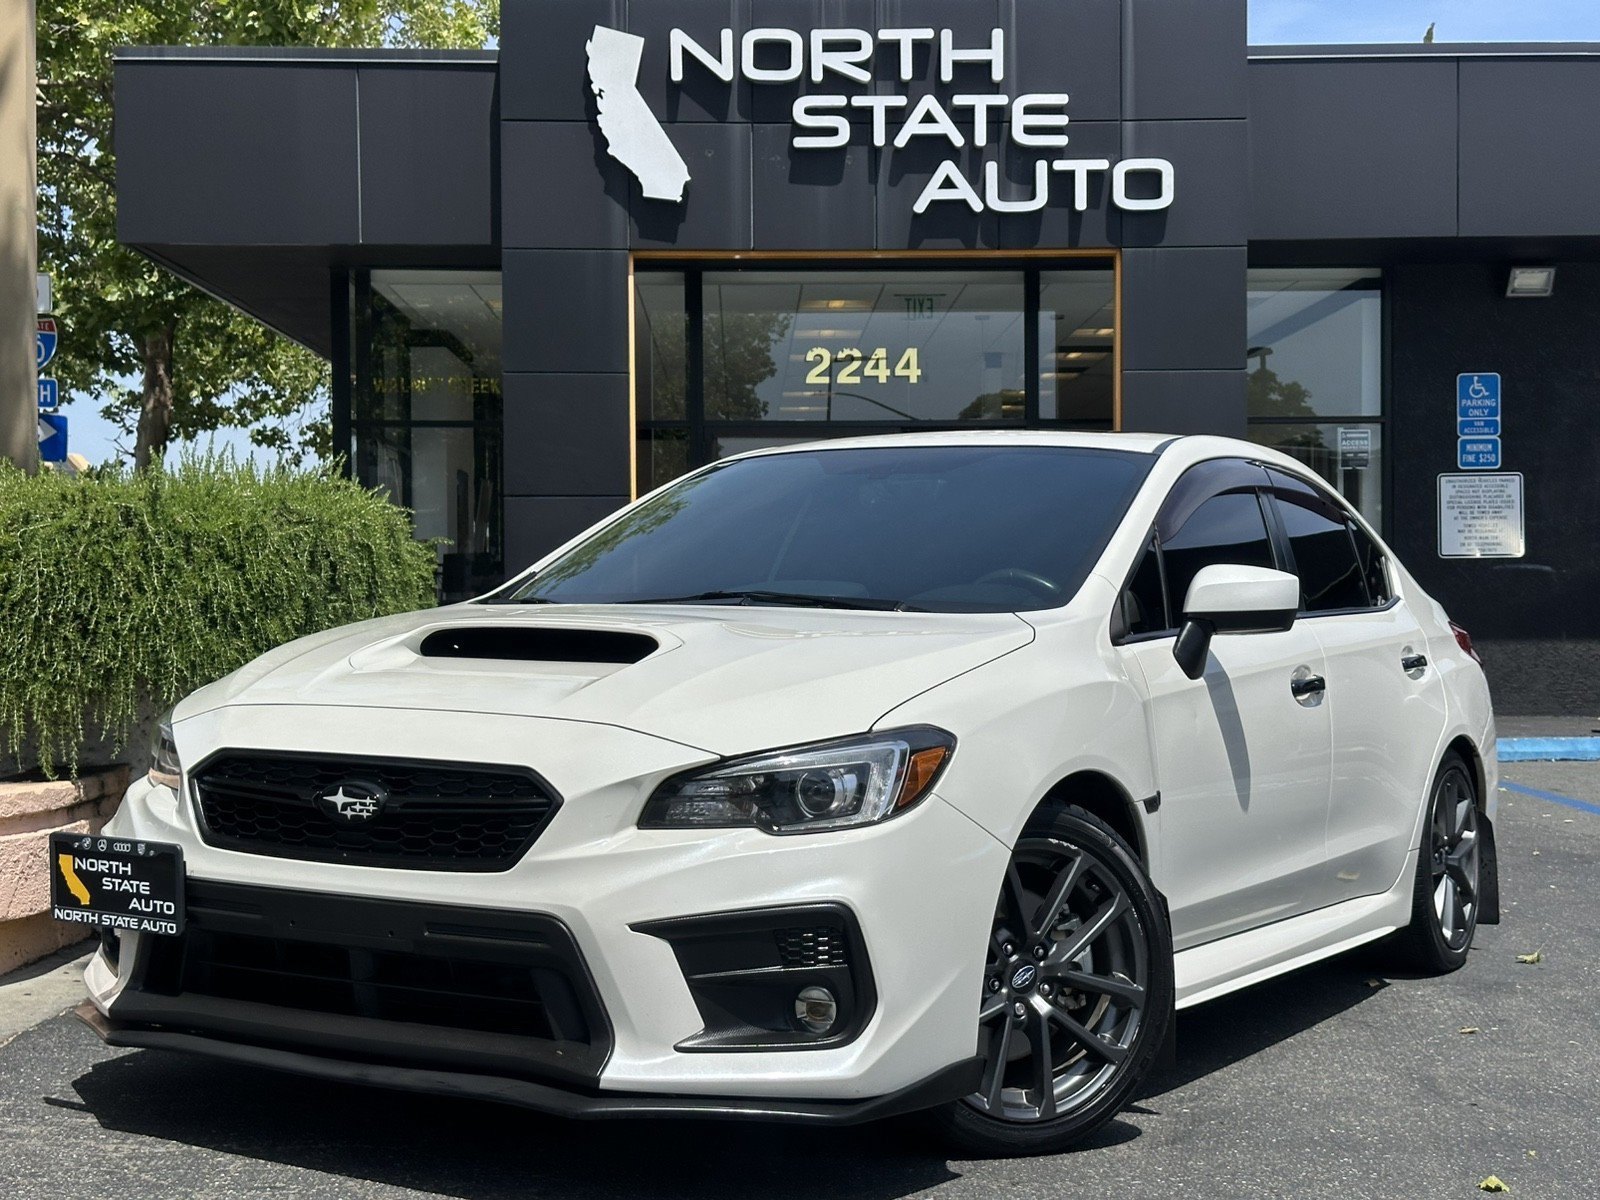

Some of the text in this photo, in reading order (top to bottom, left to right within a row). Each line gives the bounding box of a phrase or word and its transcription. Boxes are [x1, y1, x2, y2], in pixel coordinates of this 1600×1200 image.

[670, 28, 1004, 84] NORTH
[792, 93, 1069, 148] STATE
[912, 158, 1174, 214] AUTO
[805, 346, 922, 384] 2244
[1462, 399, 1496, 407] PARKING
[1469, 408, 1489, 416] ONLY
[1466, 443, 1492, 452] MINIMUM
[1462, 453, 1496, 463] FINE $250
[74, 858, 131, 875] NORTH
[102, 878, 150, 894] STATE
[128, 898, 175, 914] AUTO
[54, 908, 176, 934] NORTH STATE AUTO
